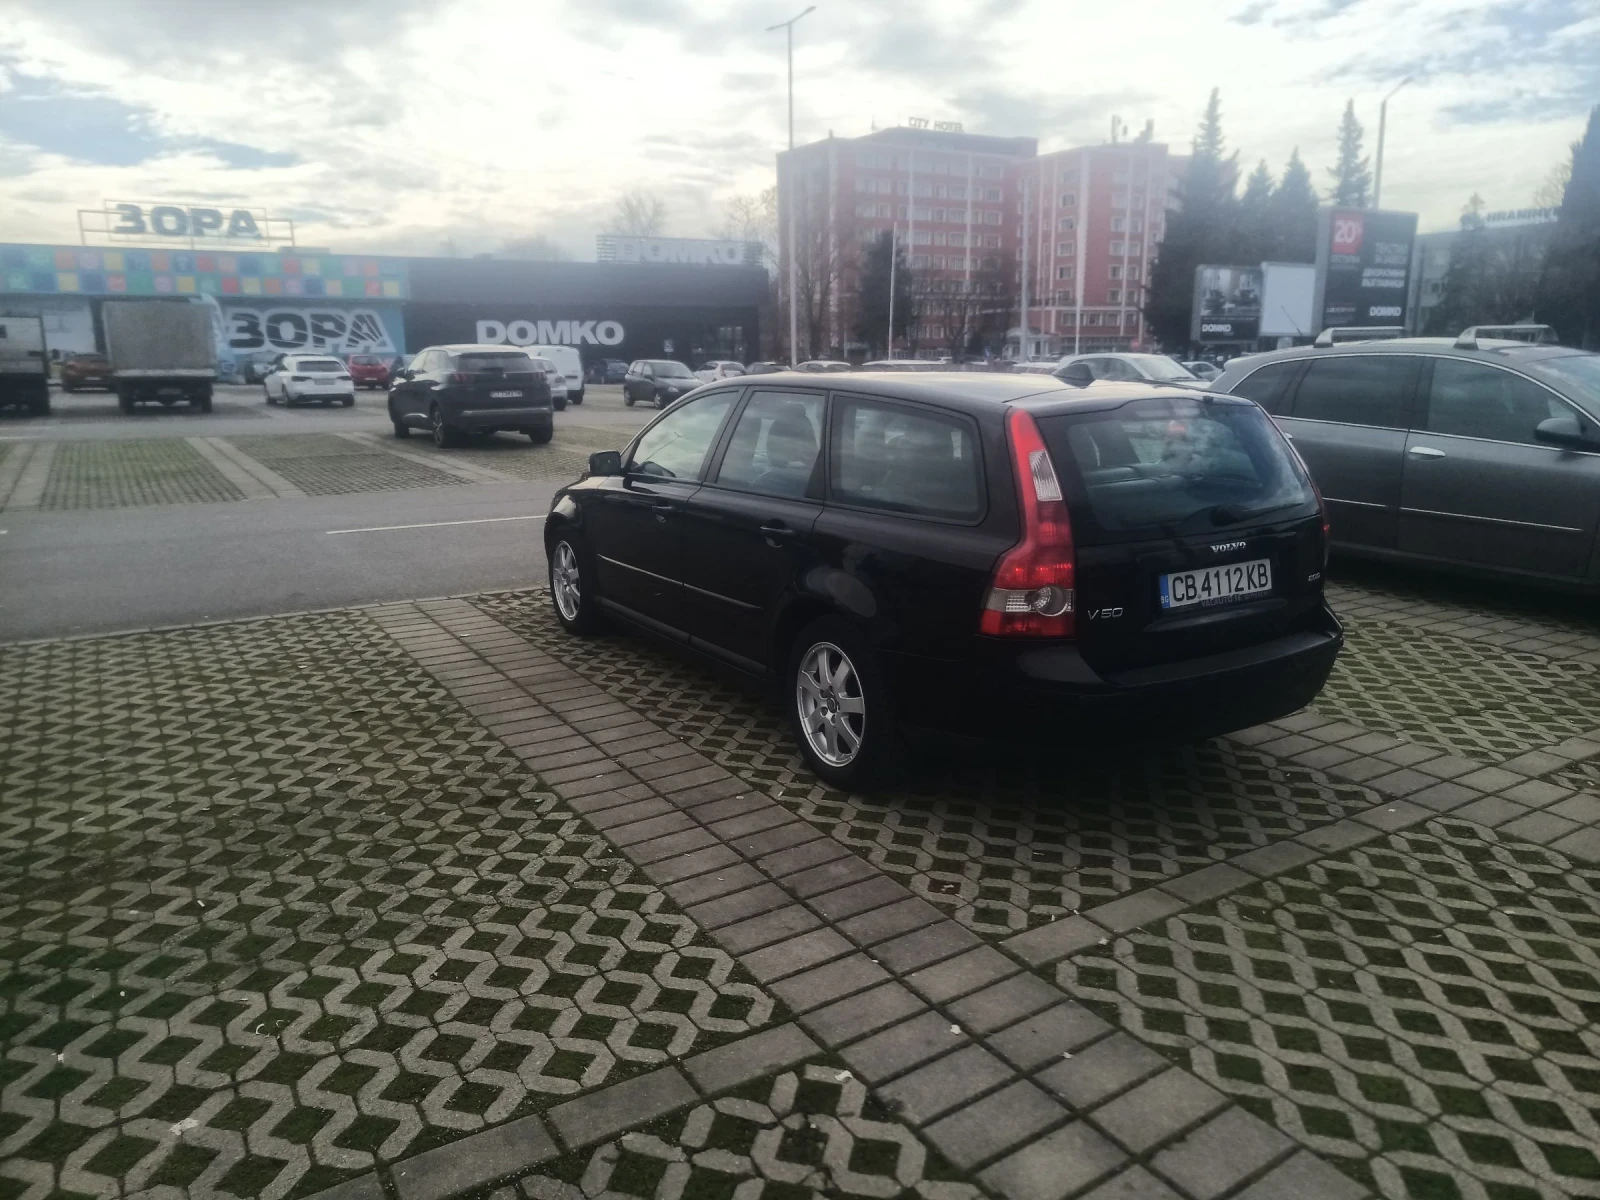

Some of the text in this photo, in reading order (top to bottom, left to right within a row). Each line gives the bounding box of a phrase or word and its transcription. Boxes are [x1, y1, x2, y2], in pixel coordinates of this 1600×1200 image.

[908, 117, 963, 132] CITY HOTEL
[114, 203, 264, 240] ЗОРА
[228, 310, 391, 351] ЗОРА
[476, 319, 625, 346] DOMKO
[1209, 541, 1247, 553] VOLVO
